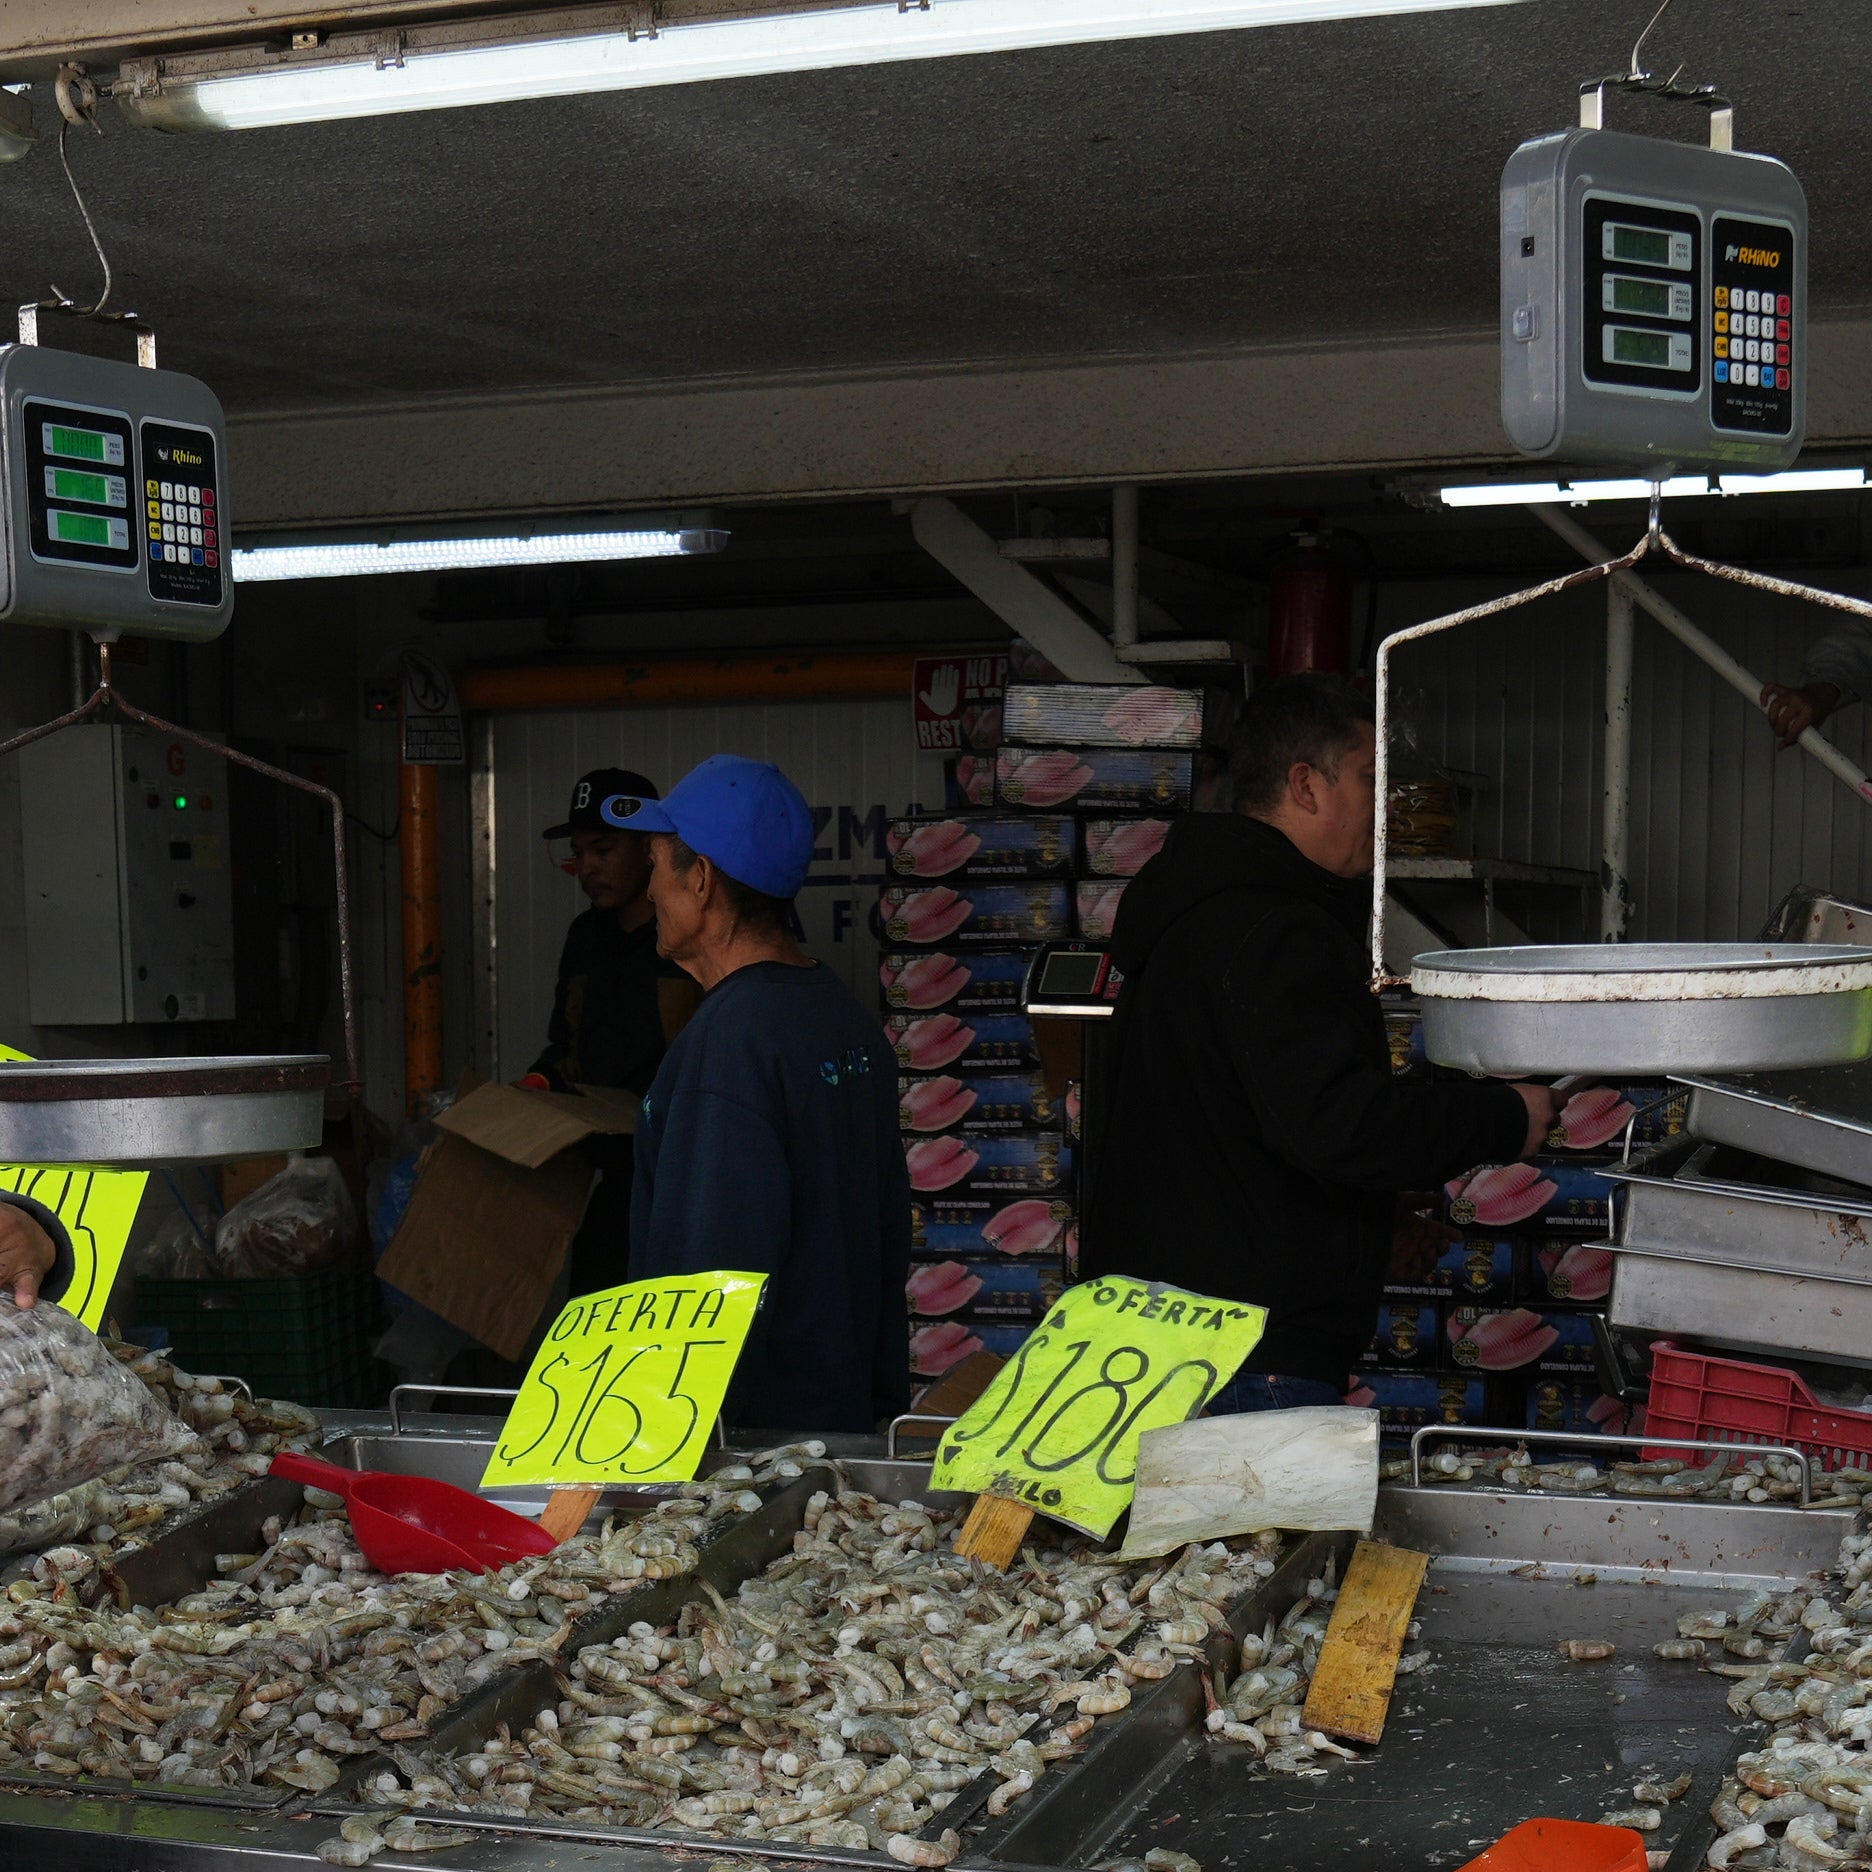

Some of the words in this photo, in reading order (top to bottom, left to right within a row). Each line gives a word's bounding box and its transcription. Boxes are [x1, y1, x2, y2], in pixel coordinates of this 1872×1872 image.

[172, 447, 203, 465] Rhino
[965, 658, 991, 687] NO
[574, 781, 592, 810] B
[551, 1288, 726, 1342] OFERTA
[499, 1340, 727, 1475] $165
[942, 1309, 1218, 1486] $180
[991, 1469, 1064, 1508] KILO
